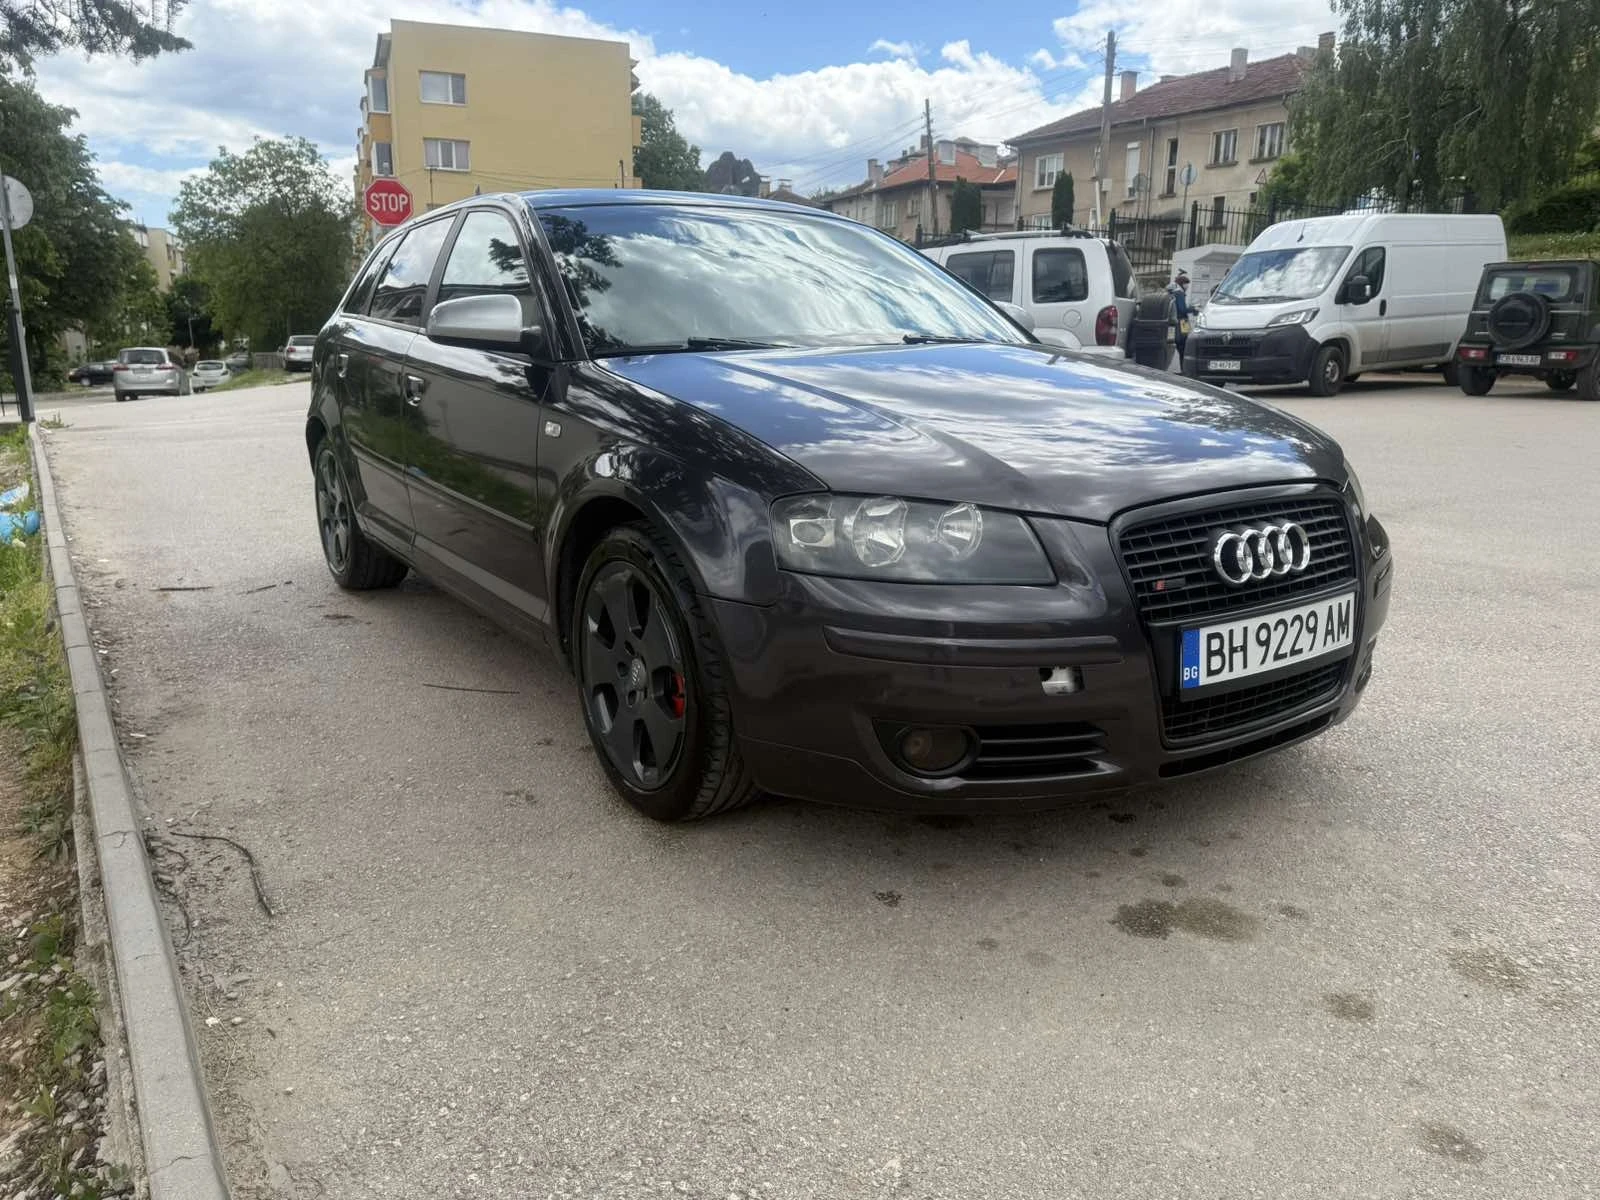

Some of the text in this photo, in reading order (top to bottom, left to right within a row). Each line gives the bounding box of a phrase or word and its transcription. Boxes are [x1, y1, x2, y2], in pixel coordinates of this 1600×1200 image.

[370, 192, 409, 212] STOP
[1206, 599, 1351, 678] BH 9229 AM
[1183, 666, 1199, 681] BG
